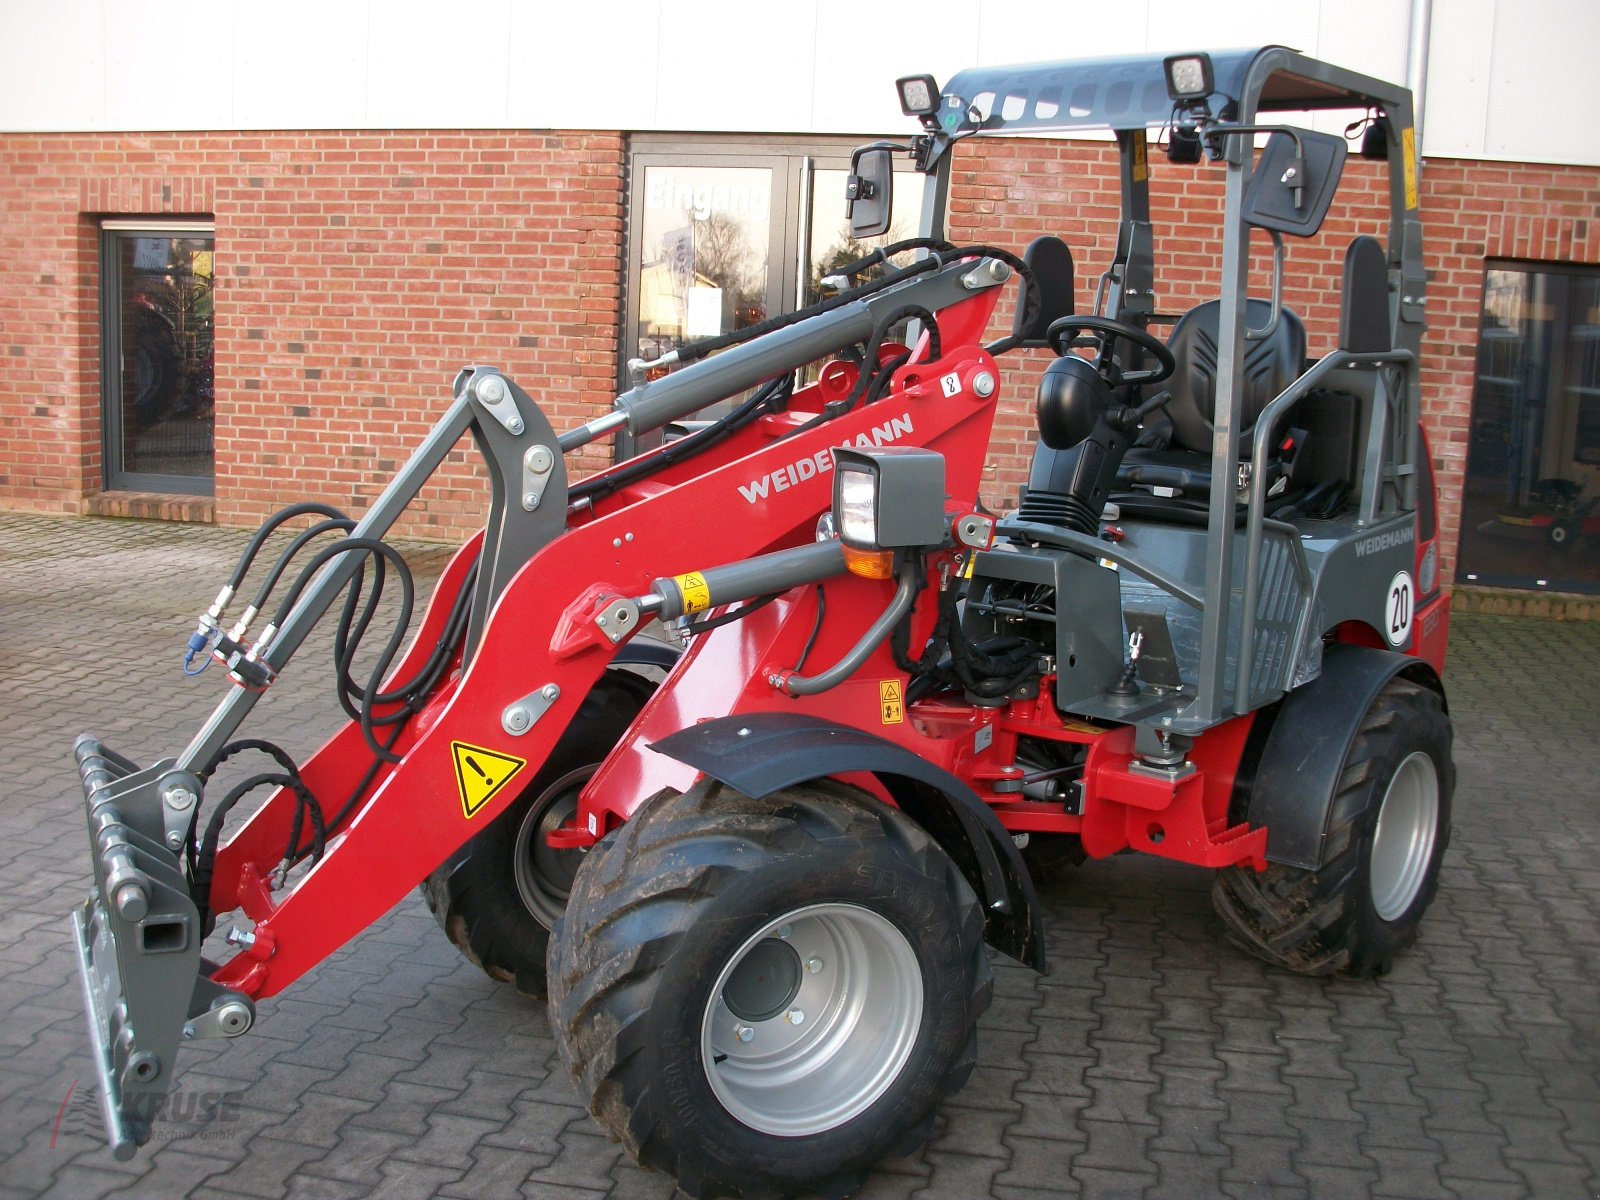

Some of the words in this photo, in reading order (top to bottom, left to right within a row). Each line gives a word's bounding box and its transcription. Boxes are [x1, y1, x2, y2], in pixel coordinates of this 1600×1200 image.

[647, 176, 770, 222] Eingang
[1354, 527, 1413, 558] WEIDEMANN
[1391, 584, 1408, 633] 20
